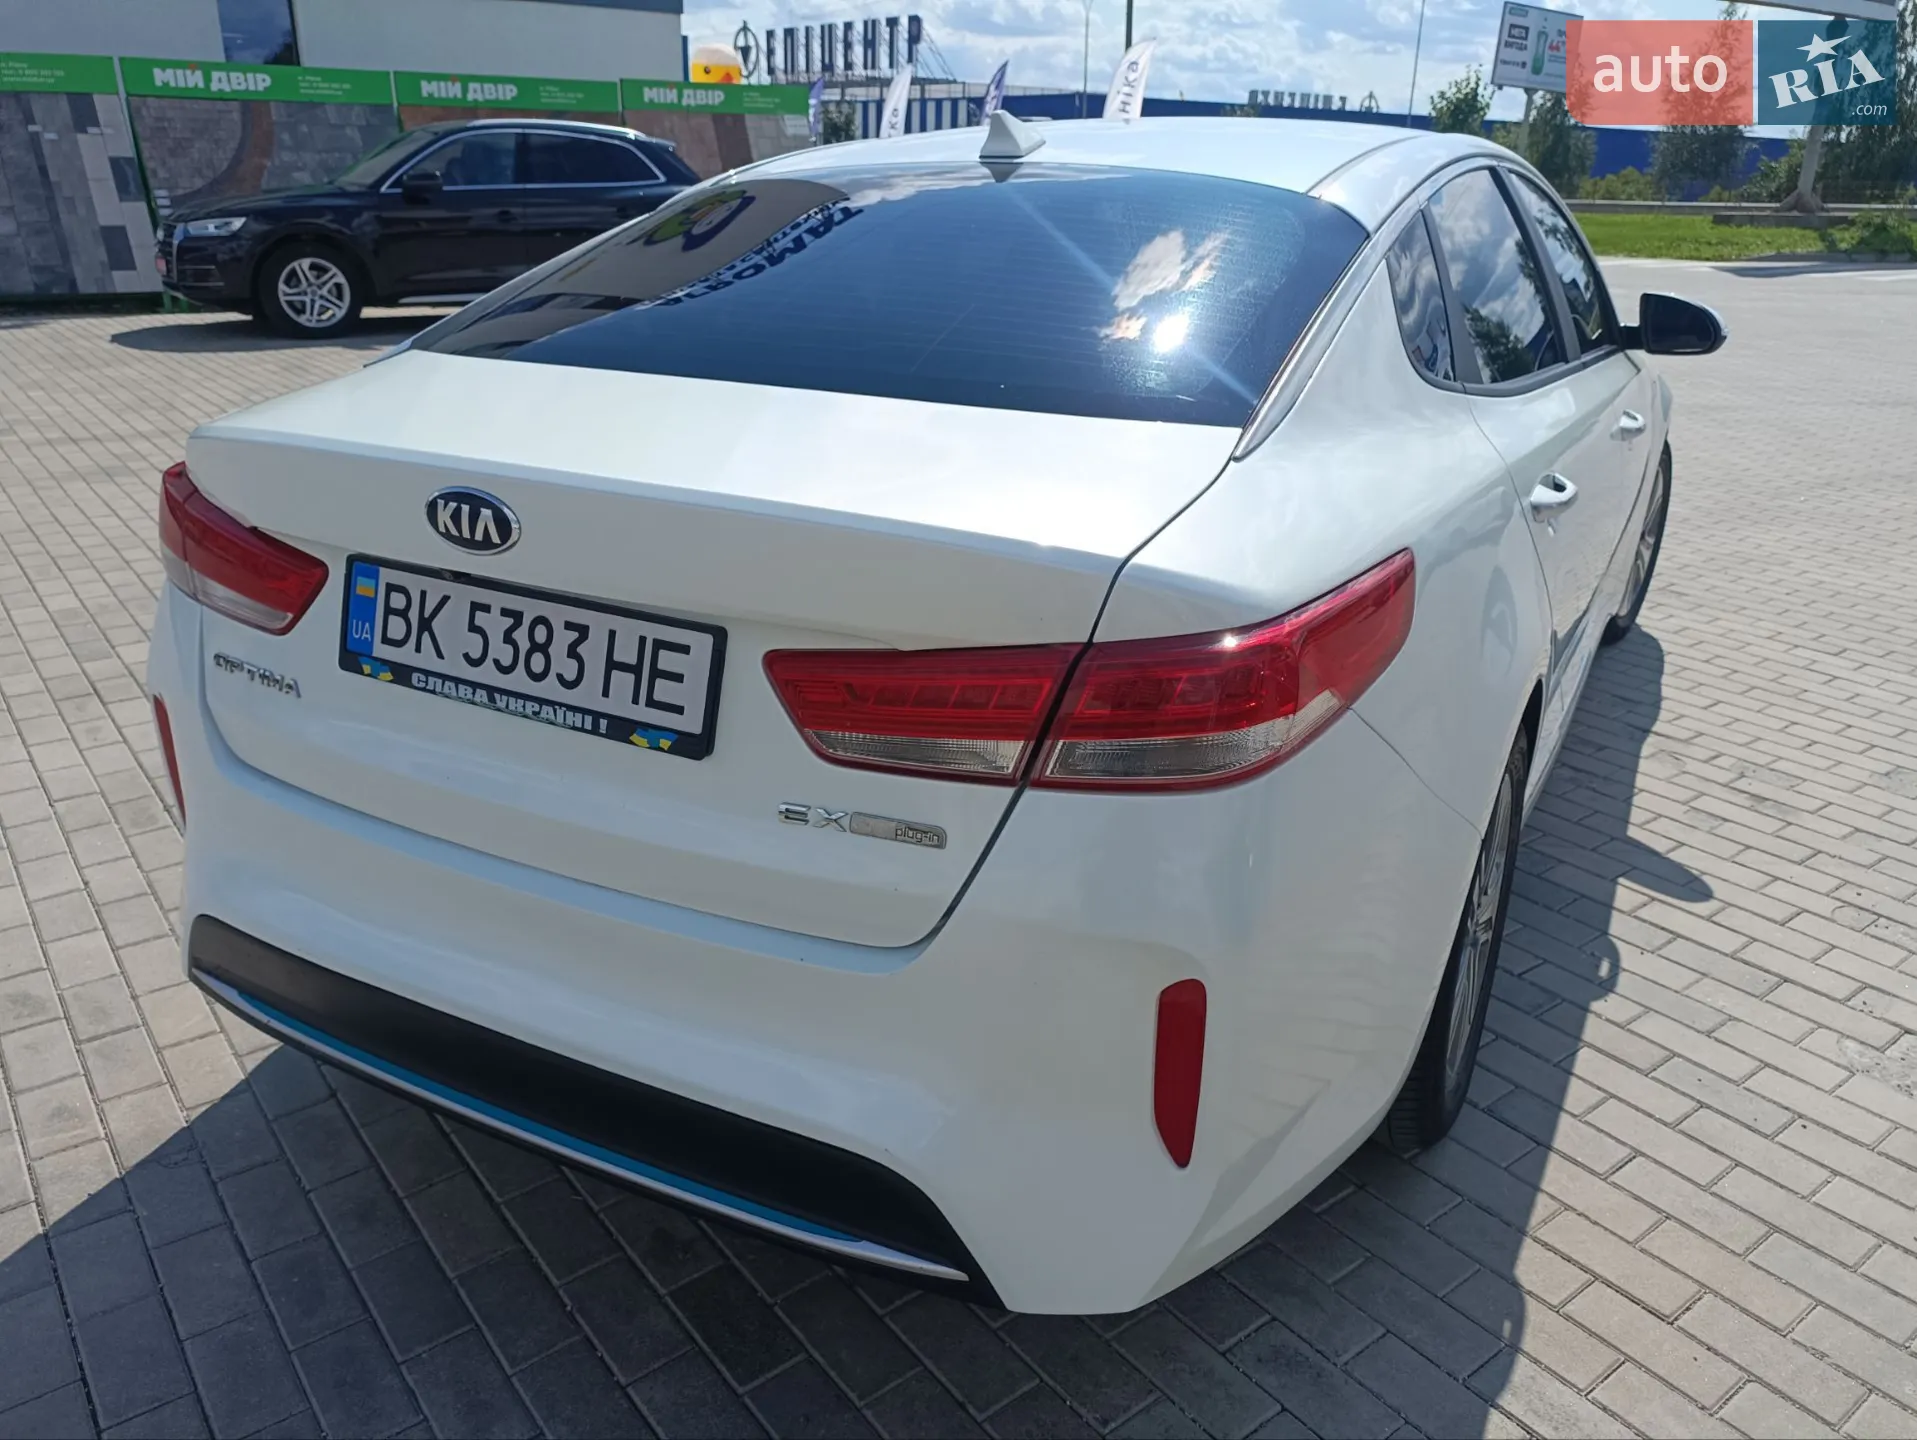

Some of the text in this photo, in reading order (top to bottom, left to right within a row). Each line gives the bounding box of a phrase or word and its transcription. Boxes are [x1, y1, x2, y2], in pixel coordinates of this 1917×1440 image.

[766, 14, 922, 77] ЕПІЦЕНТР
[153, 64, 204, 89] МІЙ
[210, 70, 272, 92] ДВІР
[420, 76, 463, 99] МІЙ
[466, 82, 518, 102] ДВІР
[643, 84, 679, 104] МІЙ
[681, 88, 725, 107] ДВІР
[437, 498, 502, 545] KIA
[352, 619, 372, 642] UA
[381, 582, 692, 716] BK 5383 HE
[213, 651, 302, 699] OPTIMA
[411, 672, 490, 706] СЛАВА
[493, 692, 594, 731] УКРАЇНІ
[778, 801, 849, 833] EX
[895, 824, 941, 844] plug-in
